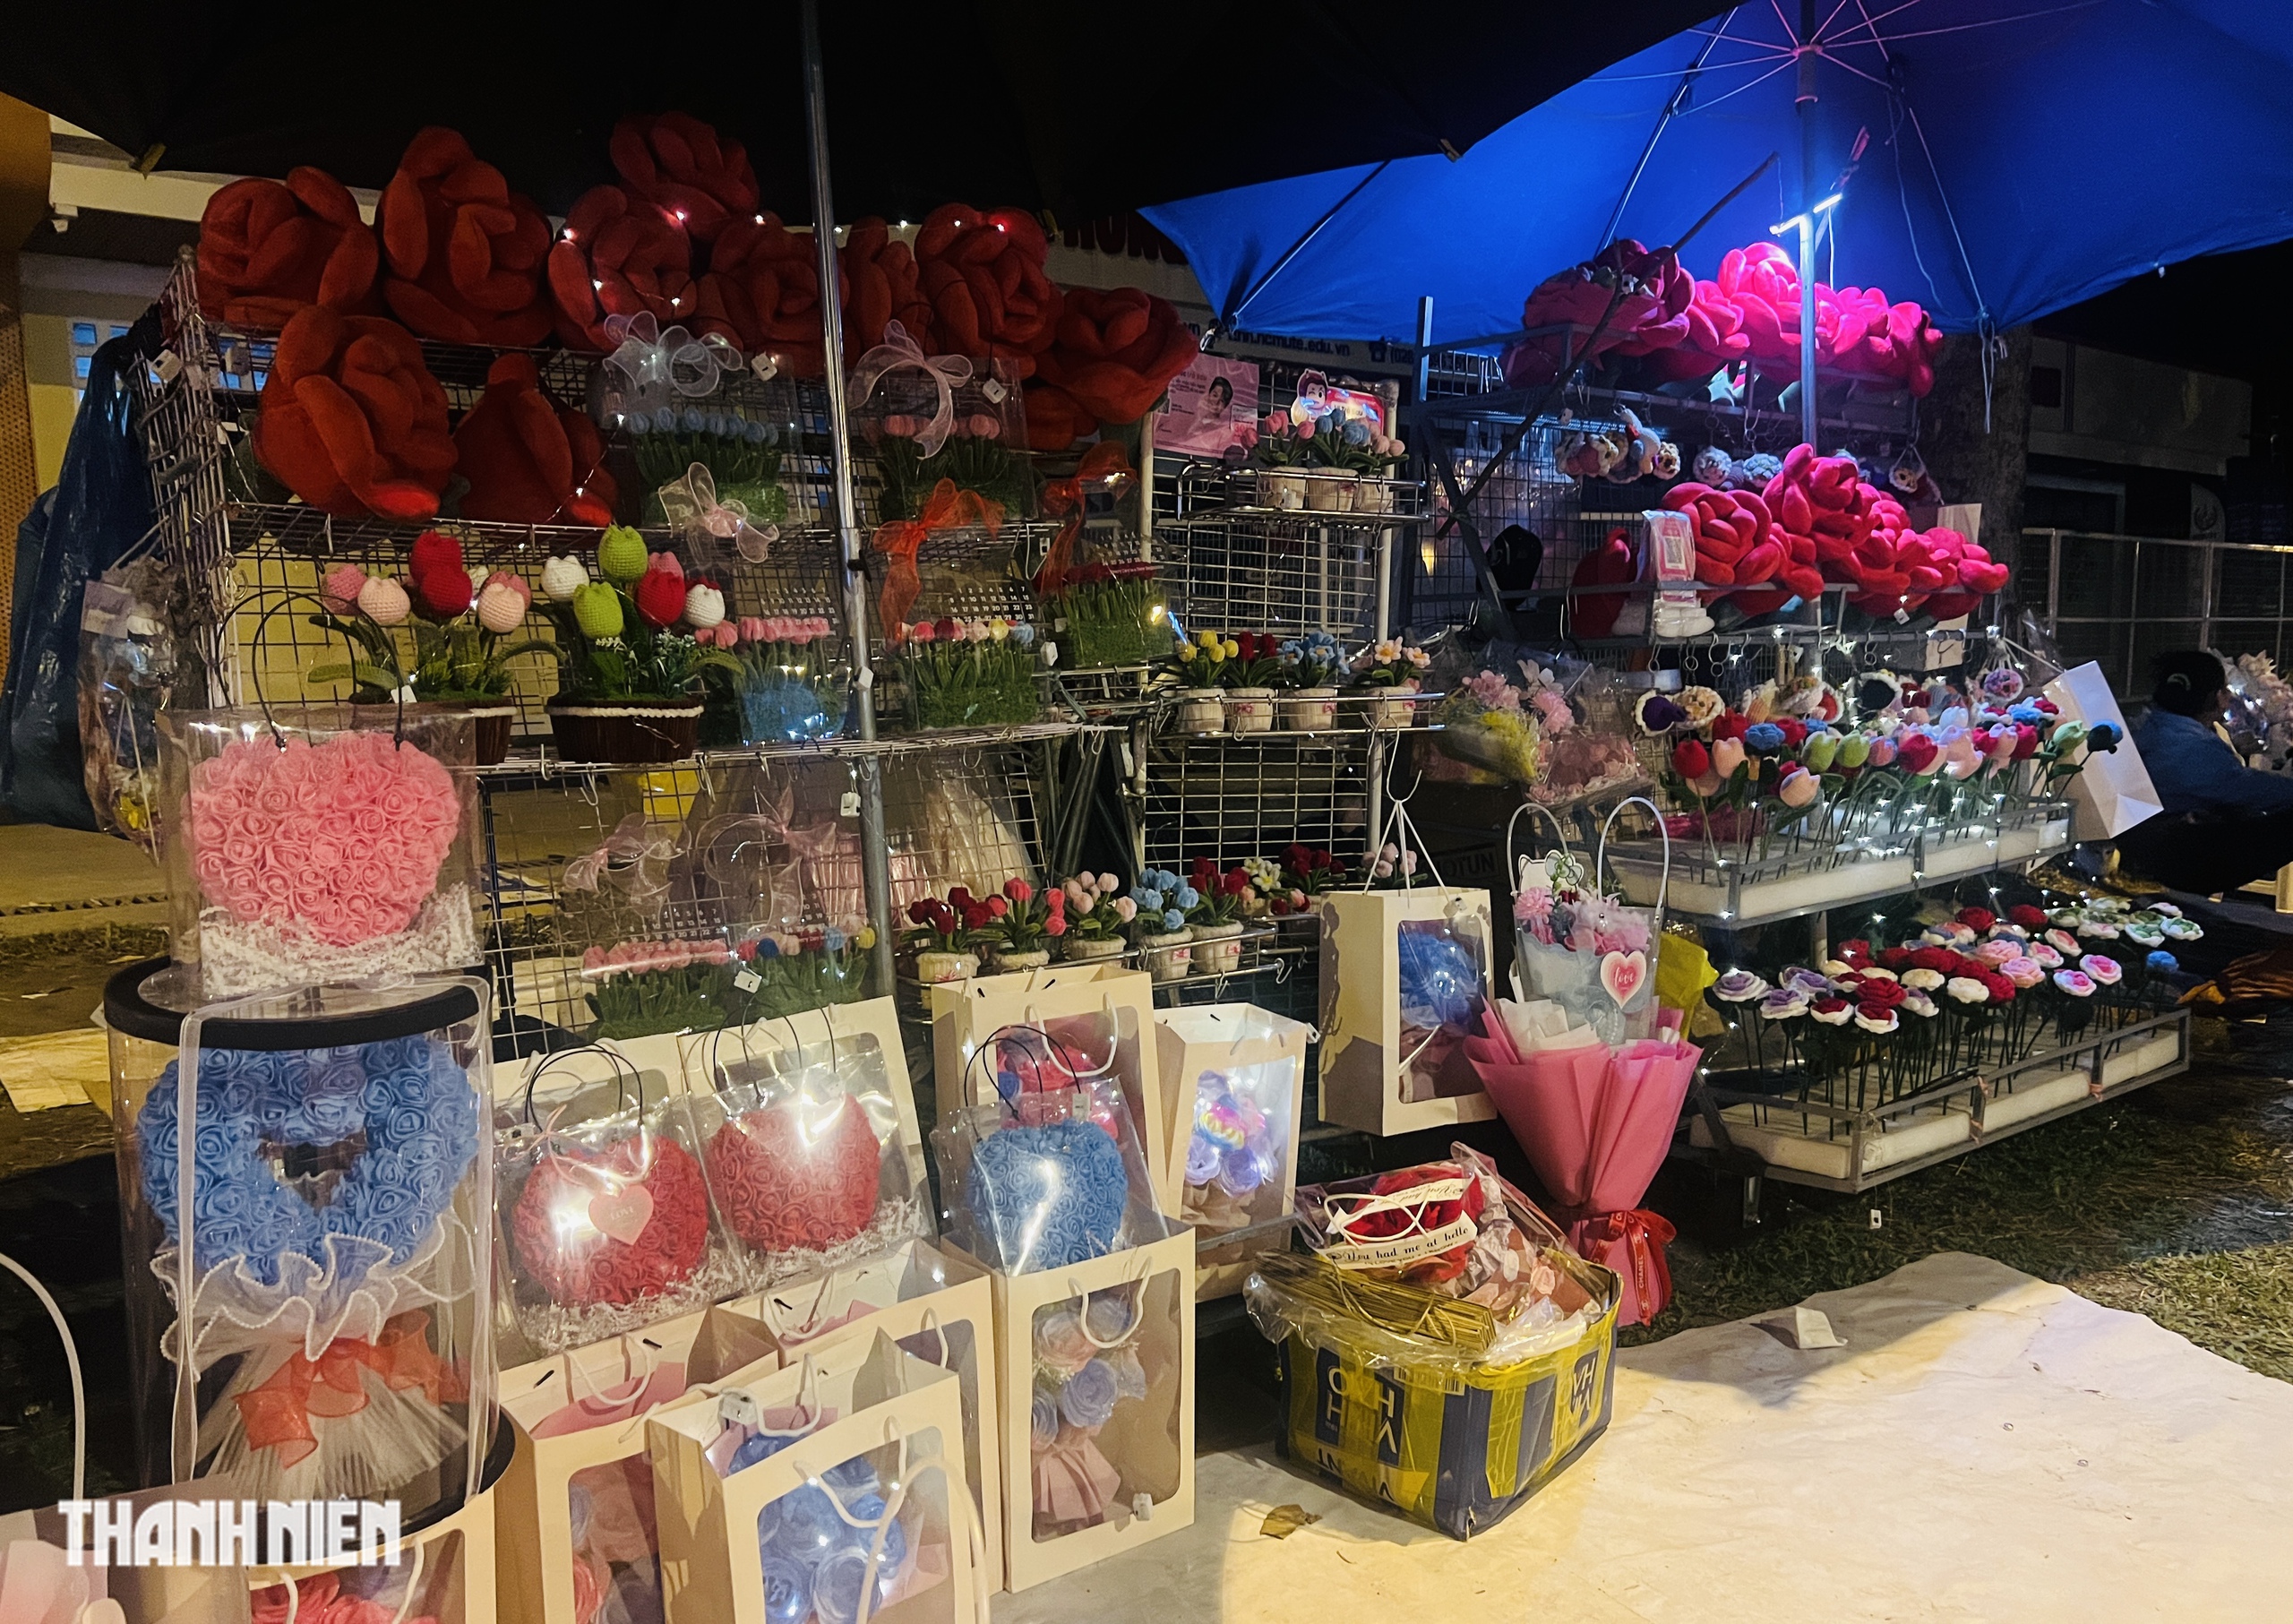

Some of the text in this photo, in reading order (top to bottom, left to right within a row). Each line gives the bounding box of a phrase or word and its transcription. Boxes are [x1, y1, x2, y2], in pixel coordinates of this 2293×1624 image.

[1615, 967, 1635, 987] love
[1376, 1247, 1398, 1259] had
[1404, 1244, 1421, 1254] me
[1427, 1239, 1438, 1248] at
[1444, 1226, 1469, 1242] hello
